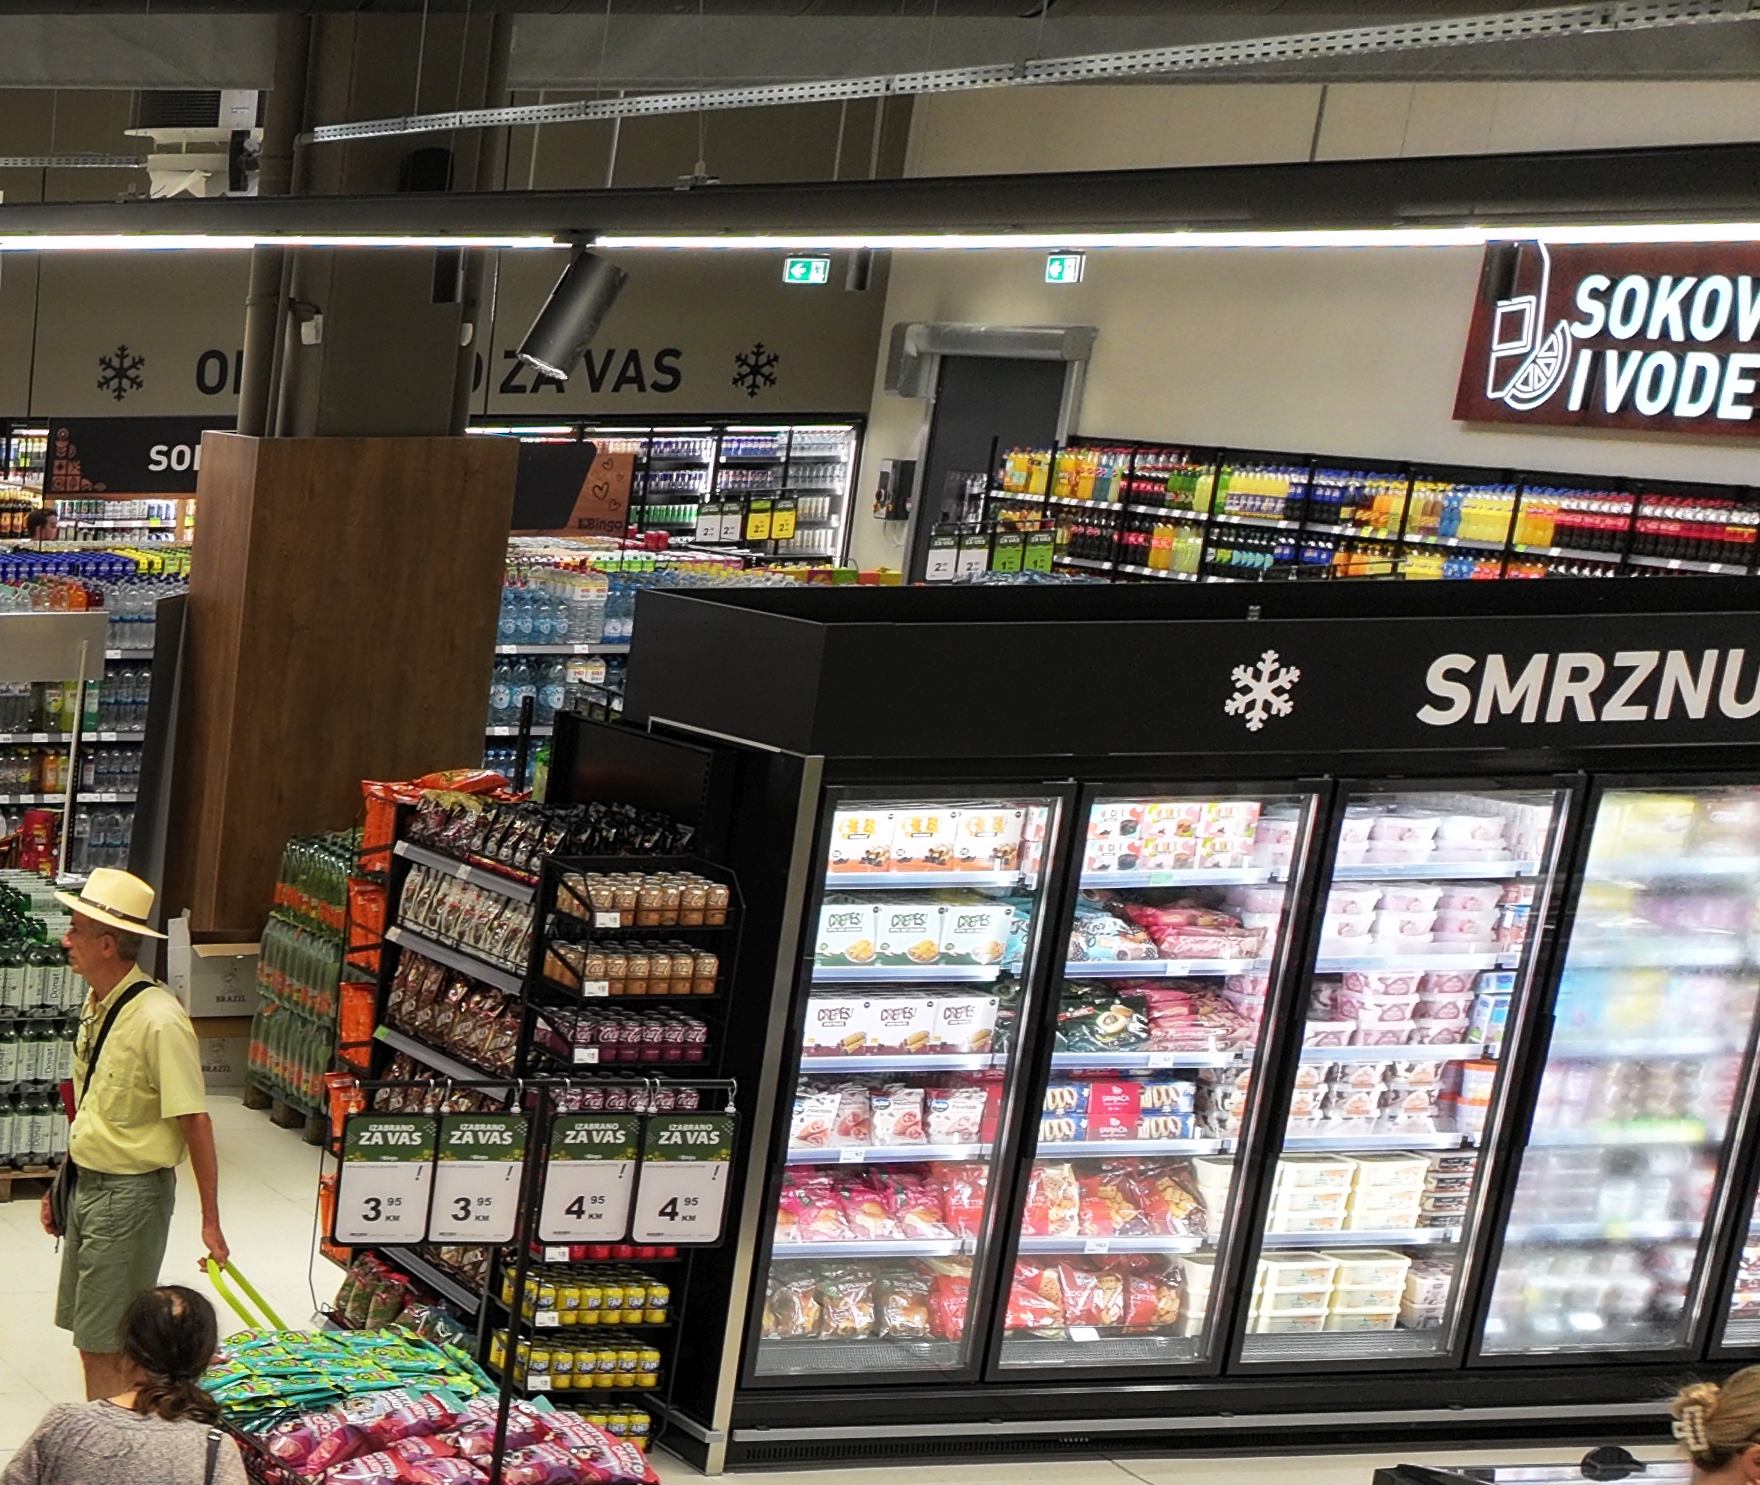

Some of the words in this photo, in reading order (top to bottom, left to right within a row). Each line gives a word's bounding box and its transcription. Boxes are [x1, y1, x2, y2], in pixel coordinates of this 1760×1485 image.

[583, 348, 683, 393] VAS
[1568, 349, 1593, 411] I
[1604, 349, 1760, 420] VODE
[1416, 649, 1760, 726] SMRZNU
[358, 1132, 389, 1145] ZA
[391, 1132, 422, 1145] VAS
[368, 1123, 415, 1132] IZABRANO
[564, 1131, 594, 1144] ZA
[595, 1131, 626, 1144] VAS
[574, 1123, 619, 1131] IZABRANO
[361, 1197, 382, 1222] 3
[387, 1197, 402, 1206] 95
[565, 1195, 586, 1220] 4
[590, 1195, 606, 1204] 95
